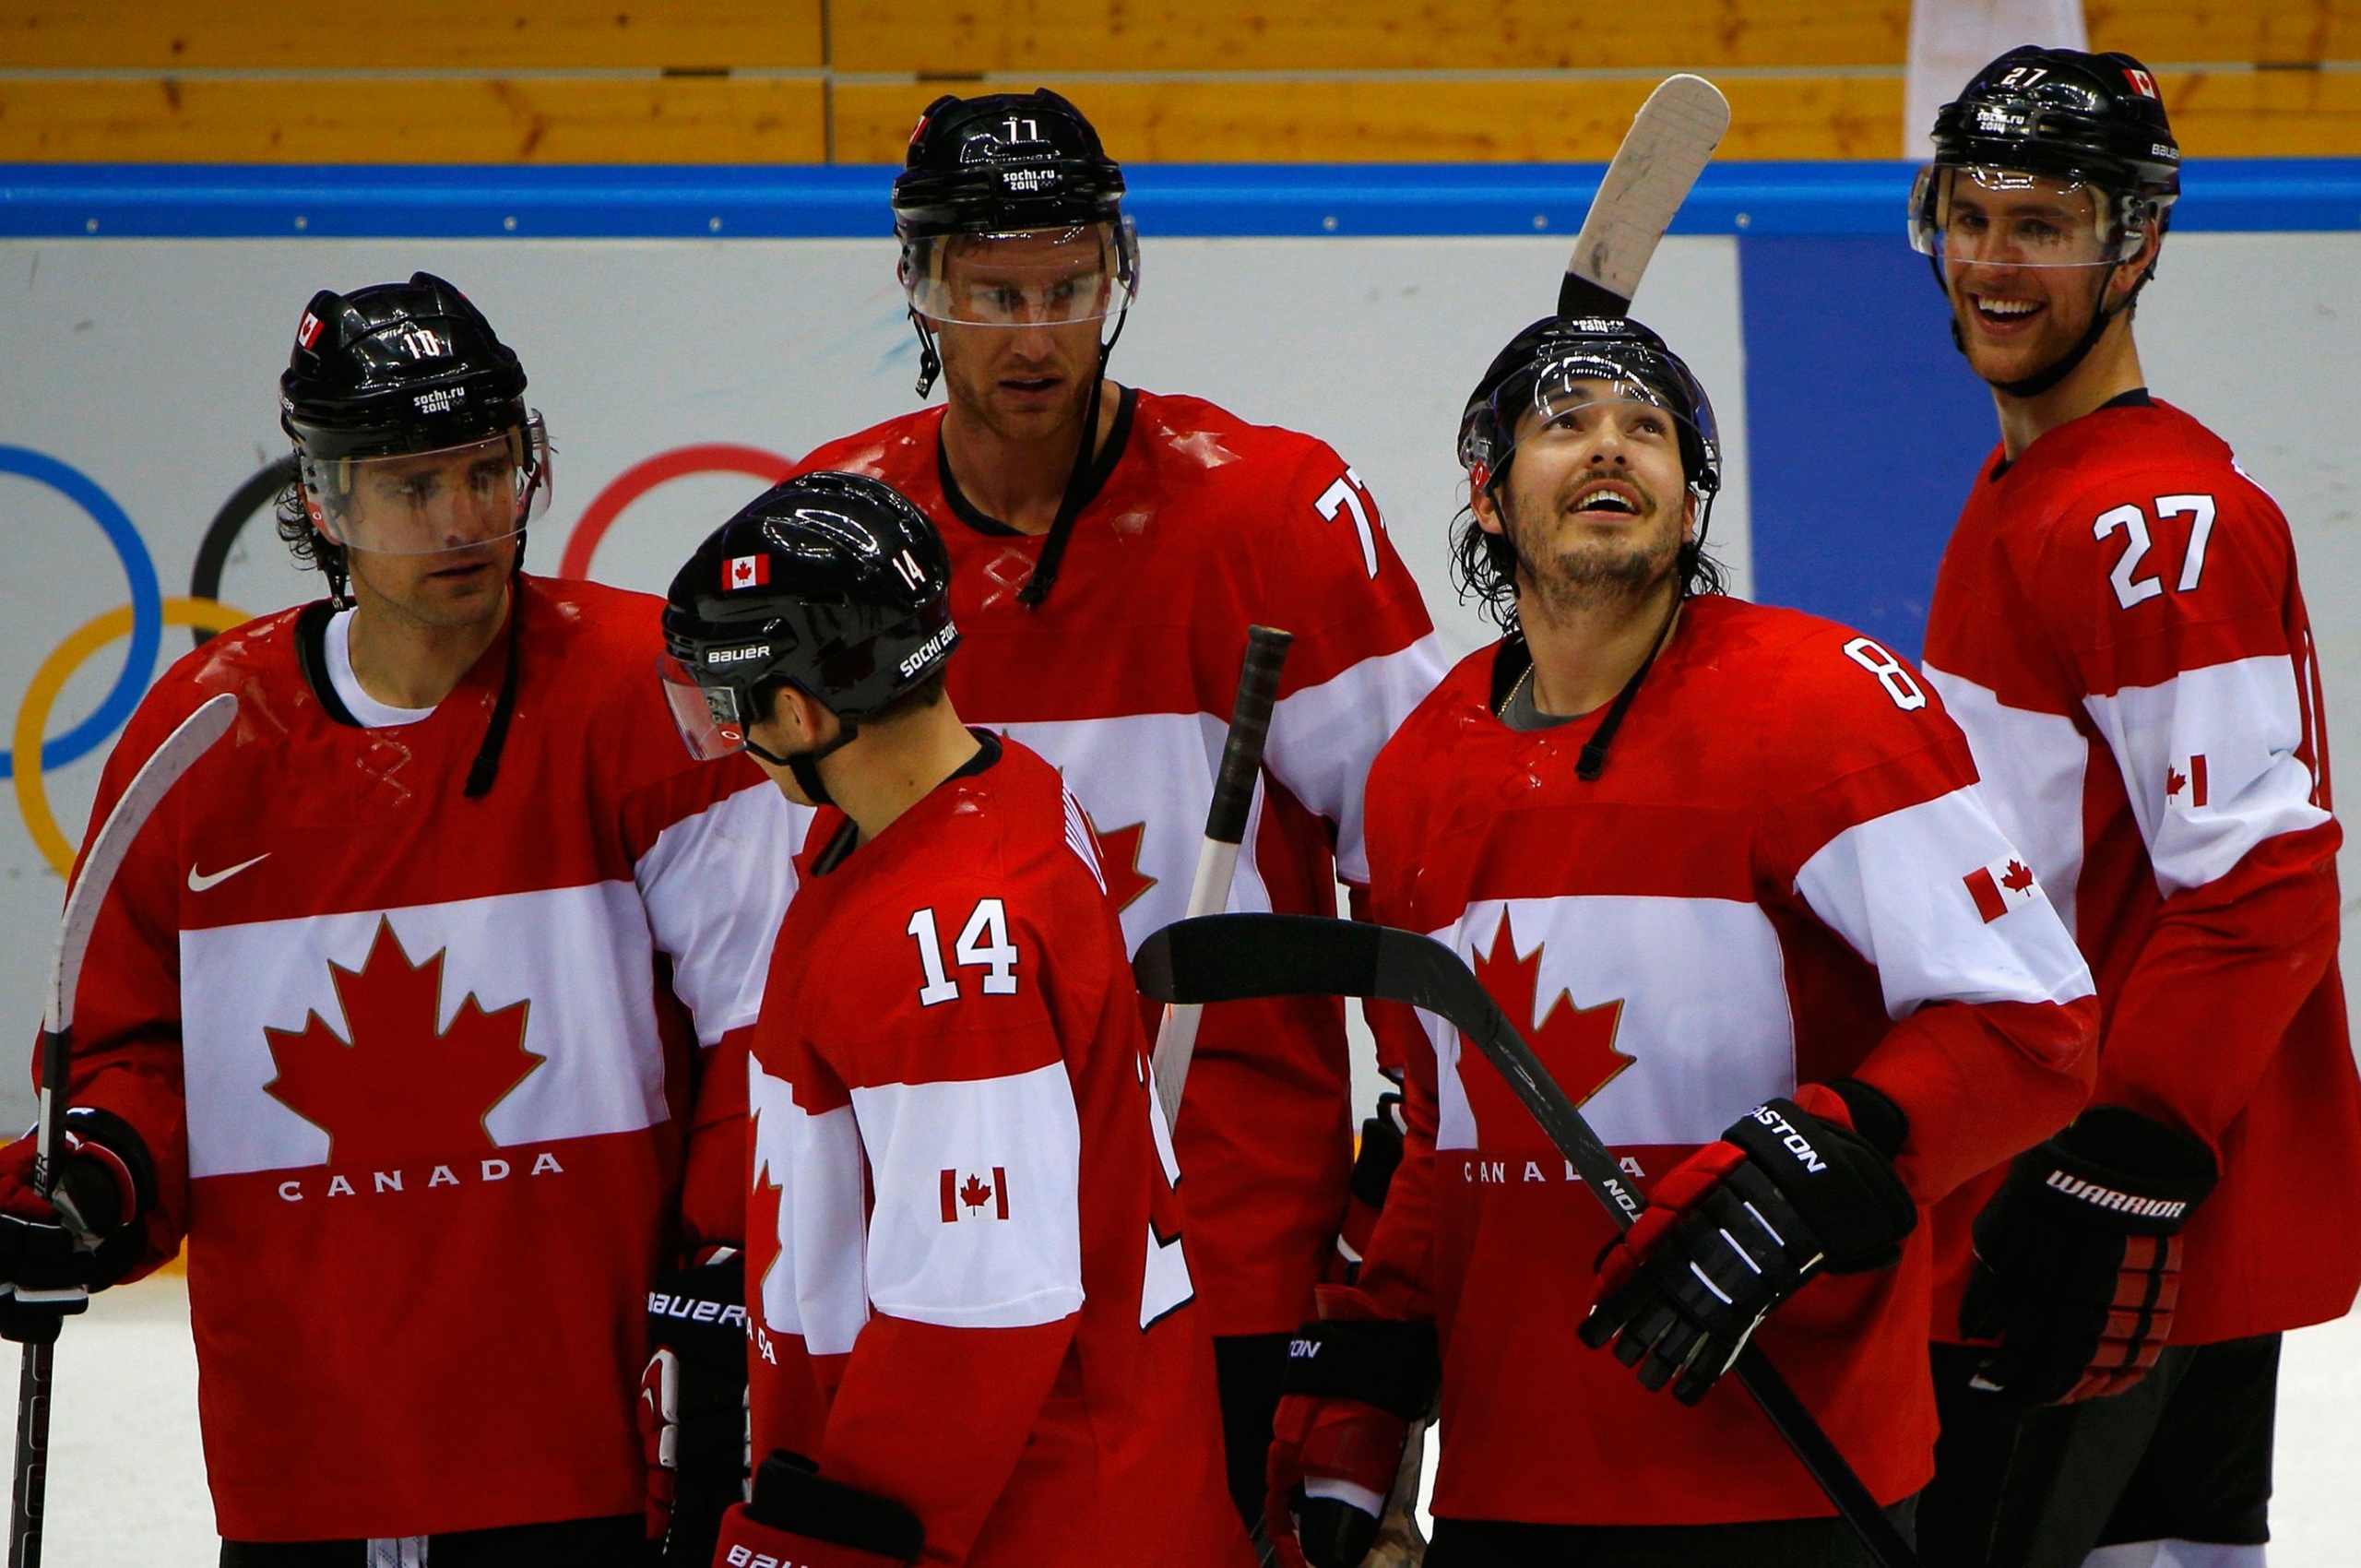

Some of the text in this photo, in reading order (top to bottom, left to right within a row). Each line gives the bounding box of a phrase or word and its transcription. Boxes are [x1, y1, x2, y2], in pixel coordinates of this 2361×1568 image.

[2000, 67, 2047, 86] 27
[1980, 122, 2006, 135] 2014
[1003, 169, 1055, 183] sochi.ru
[1011, 180, 1038, 191] 2014
[413, 387, 466, 408] sochi.ru
[422, 399, 451, 414] 2014
[893, 550, 927, 590] 14
[2093, 493, 2216, 610] 27
[899, 636, 942, 678] SOCHI
[1843, 636, 1928, 712] 8
[907, 898, 1018, 1006] 14
[279, 1153, 564, 1201] CANADA
[2047, 1170, 2187, 1218] WARRIOR
